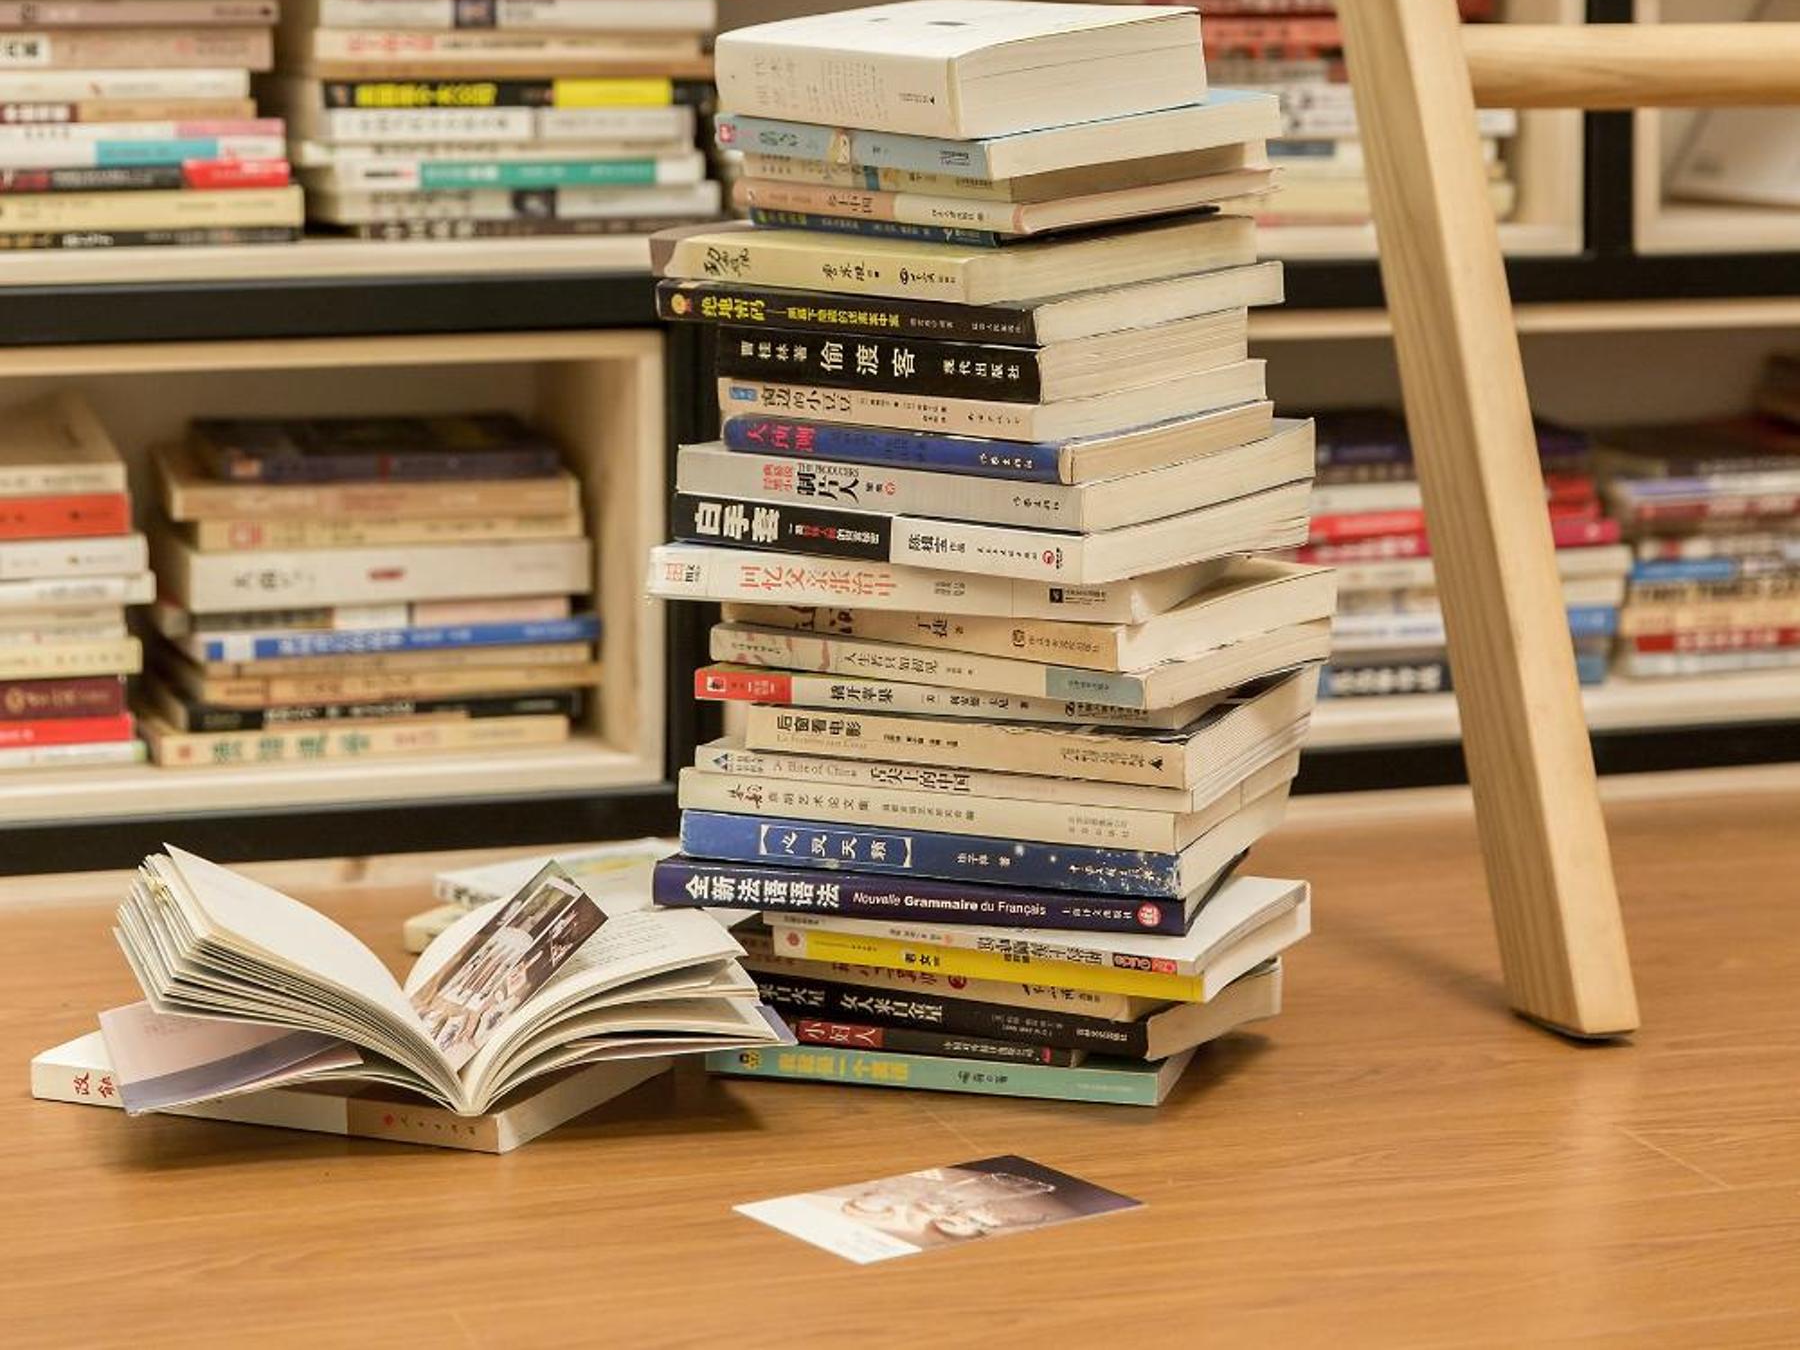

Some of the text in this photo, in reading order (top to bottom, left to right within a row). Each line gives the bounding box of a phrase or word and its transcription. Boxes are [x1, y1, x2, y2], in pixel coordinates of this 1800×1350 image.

[819, 341, 916, 379] 偷渡客
[942, 358, 1021, 380] 现代出版社
[761, 384, 852, 416] 窗边的小豆豆
[797, 471, 860, 504] 制片人
[694, 501, 780, 543] 白手套
[739, 564, 897, 597] 回忆父亲张治中
[844, 654, 938, 674] 人生若只如初见
[830, 684, 894, 703] 撬开苹果
[777, 714, 862, 738] 后窗看电影
[870, 767, 970, 792] 舌尖上的中国
[684, 873, 840, 909] 全新法语语法
[852, 891, 1048, 917] Nouvelle Grammaire du Français
[804, 1021, 877, 1047] 小妇人
